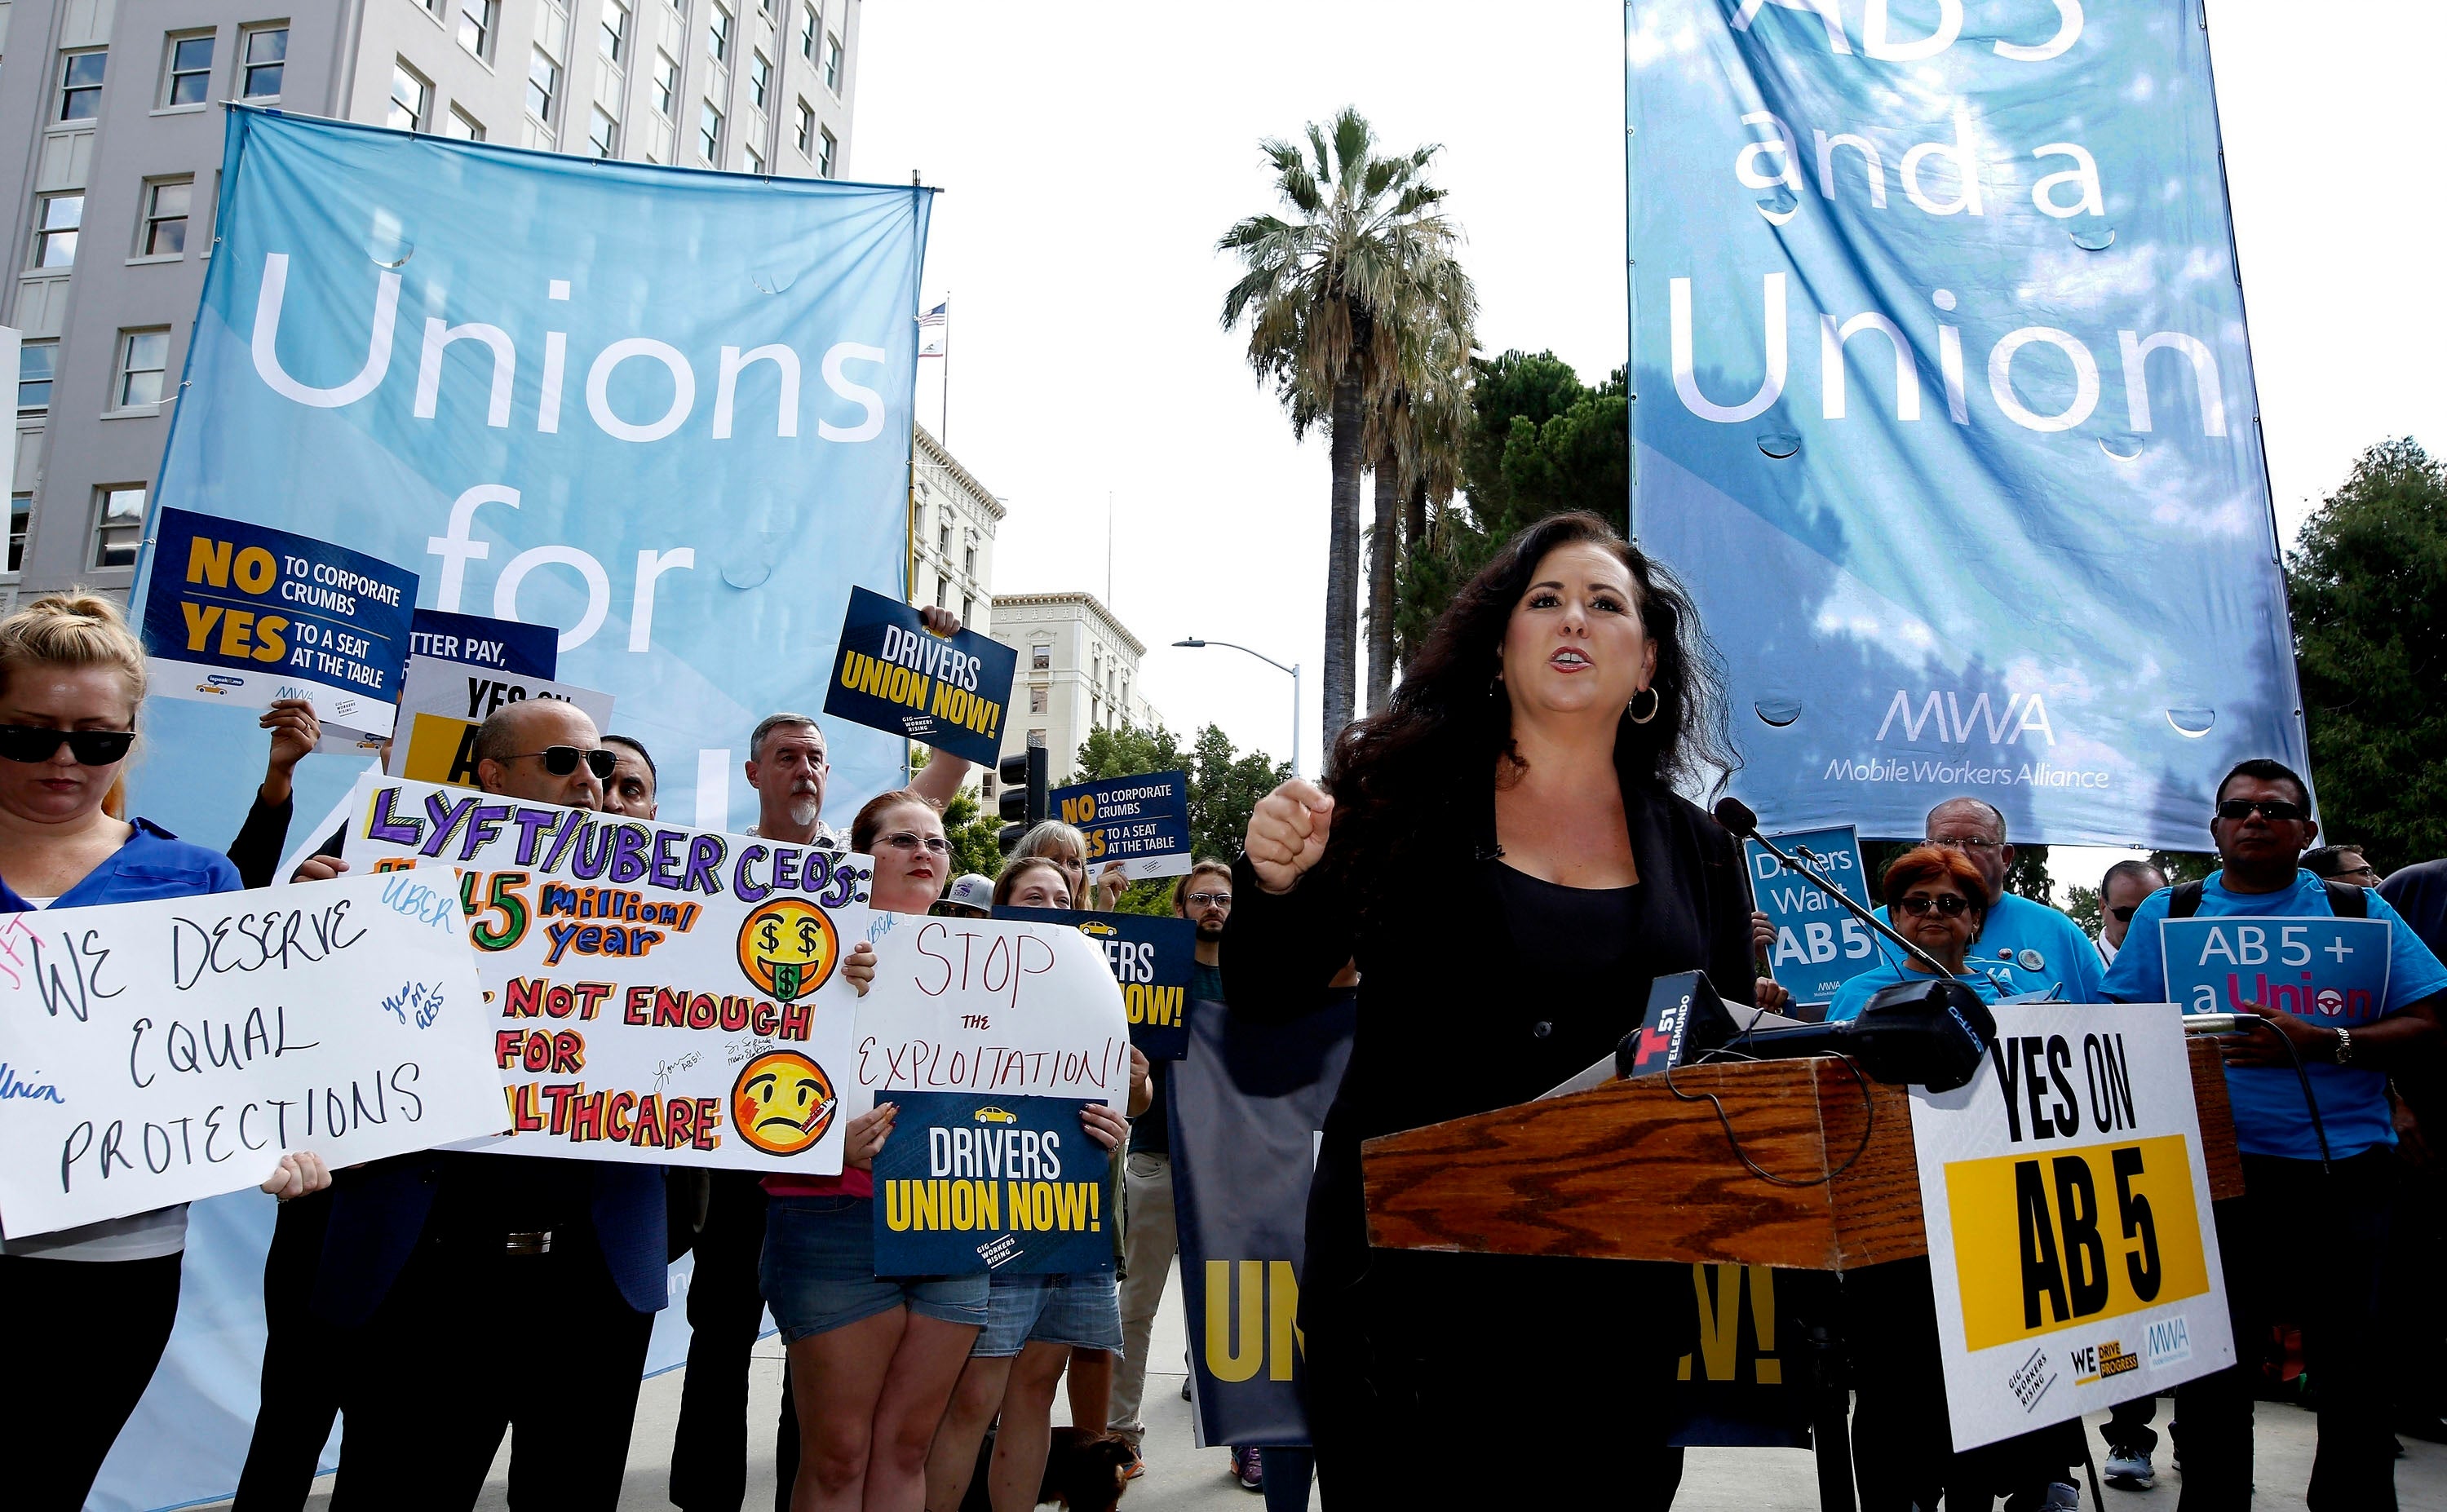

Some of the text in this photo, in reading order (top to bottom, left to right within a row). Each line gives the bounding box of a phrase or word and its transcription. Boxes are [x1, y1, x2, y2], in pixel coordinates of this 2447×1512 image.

[1735, 98, 2105, 218] and a
[251, 252, 887, 443] Unions
[1669, 272, 2228, 438] Union
[186, 536, 277, 595] NO
[284, 555, 401, 608] TO CORPORATE
[427, 484, 694, 653] for
[281, 581, 356, 617] CRUMBS
[180, 601, 290, 663] YES
[294, 621, 370, 660] TO A SEAT
[409, 631, 506, 667] TTER PAY,
[290, 647, 315, 669] AT
[316, 652, 344, 678] THE
[347, 663, 384, 689] TABLE
[881, 624, 981, 692] DRIVERS
[275, 686, 314, 702] MWA
[841, 650, 1001, 740] UNION NOW!
[905, 719, 933, 727] WORKERS
[1876, 690, 2056, 745] MWA
[1096, 784, 1172, 805] TO CORPORATE
[1824, 758, 2109, 789] Mobile Workers Alliance
[1061, 794, 1096, 825] NO
[1098, 802, 1140, 819] CRUMBS
[1107, 824, 1157, 840] TO A SEAT
[365, 786, 728, 896] LYFT/UBER
[1085, 829, 1107, 859] ES
[1108, 836, 1175, 855] AT THE TABLE
[381, 876, 454, 934] UBER
[30, 930, 127, 1022] WE
[172, 900, 368, 990] DESERVE
[542, 920, 666, 967] year
[1774, 917, 1872, 966] AB 5
[2198, 926, 2269, 966] AB
[2281, 926, 2312, 966] 5
[914, 922, 1055, 1009] STOP
[1817, 980, 1841, 992] MWA
[502, 976, 816, 1042] NOT ENOUGH
[1119, 983, 1184, 1028] OW!
[1657, 1007, 1677, 1032] 51
[2193, 984, 2219, 1014] a
[961, 1014, 991, 1030] THE
[131, 1006, 320, 1089] EQUAL
[495, 1028, 586, 1075] FOR
[858, 1037, 1126, 1092] EXPLOITATION!
[1993, 1032, 2138, 1143] YES ON
[61, 1063, 423, 1194] PROTECTIONS
[503, 1081, 724, 1152] LTHCARE
[929, 1126, 1061, 1180] DRIVERS
[885, 1179, 1101, 1233] UNION NOW!
[976, 1243, 990, 1253] GIG
[981, 1237, 1016, 1259] WORKERS
[986, 1249, 1011, 1265] RISING
[2014, 1146, 2162, 1331] AB 5
[2070, 1342, 2121, 1376] WE DRIVE
[2148, 1318, 2189, 1357] MWA
[2008, 1370, 2022, 1389] GIG
[2013, 1354, 2047, 1399] WORKERS
[2100, 1355, 2138, 1377] PROGRESS
[2020, 1373, 2045, 1408] RISING
